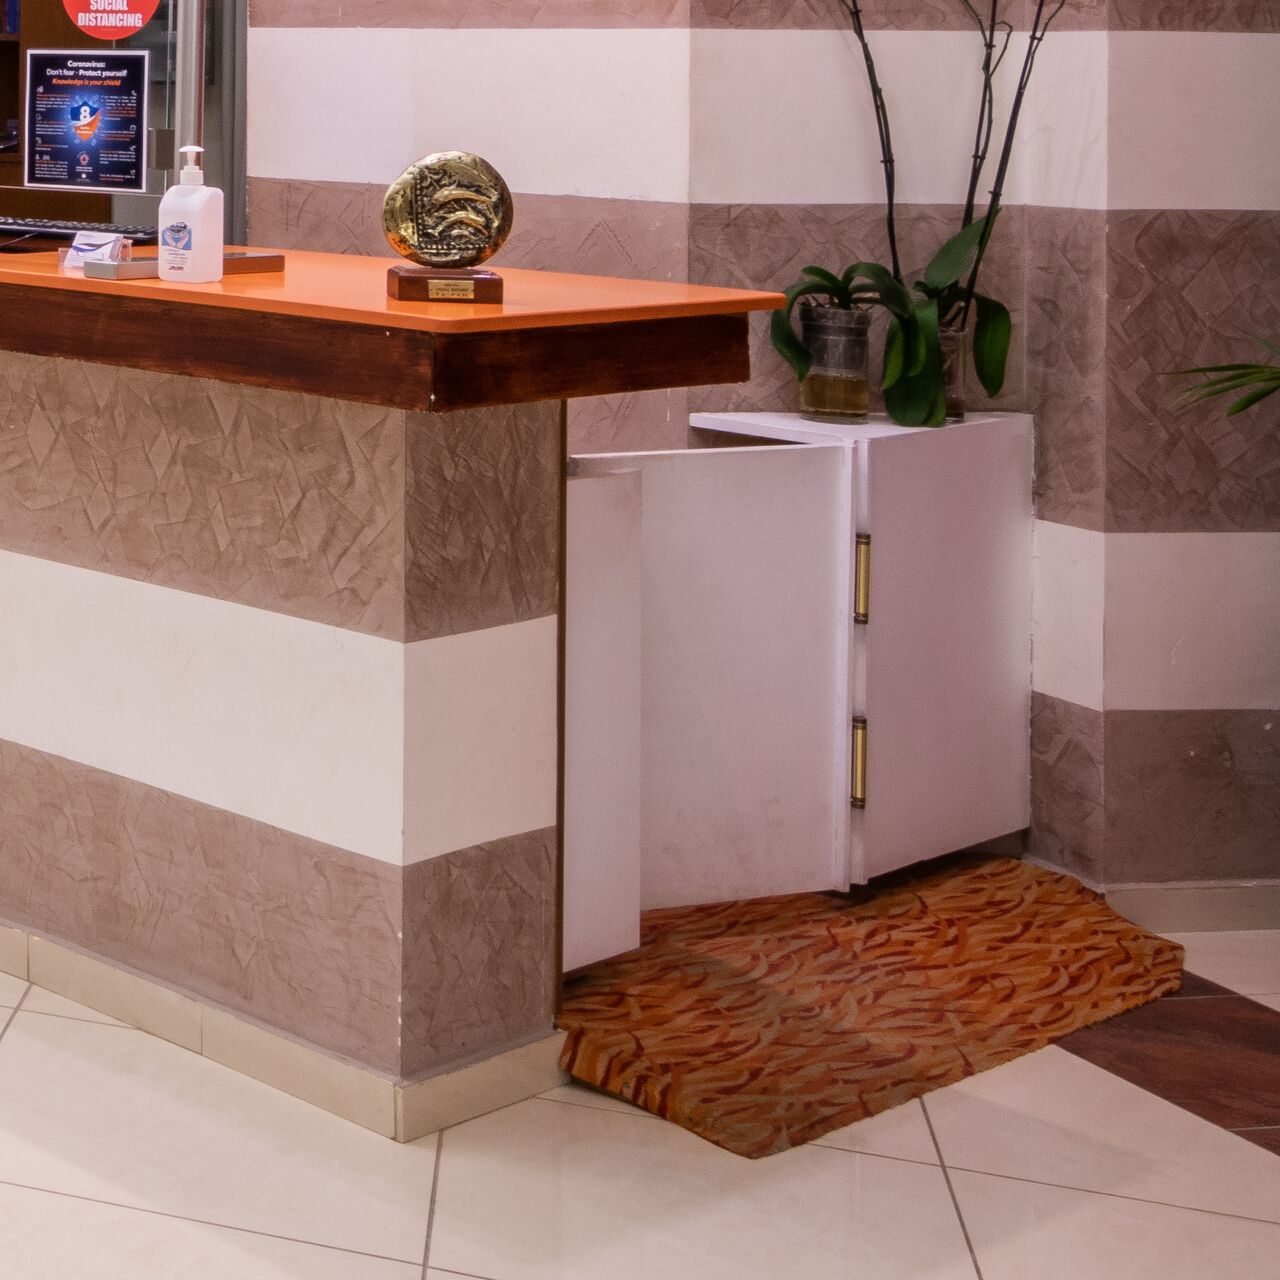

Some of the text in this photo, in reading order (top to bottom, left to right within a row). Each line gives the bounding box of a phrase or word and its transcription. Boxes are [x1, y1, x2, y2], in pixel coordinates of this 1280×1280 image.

[77, 12, 142, 27] DISTANCING
[67, 60, 105, 68] Coronavirus:
[46, 68, 63, 76] Don't
[64, 68, 75, 76] fear
[79, 69, 102, 77] Protect
[102, 69, 128, 78] yourself
[52, 78, 84, 86] Knowledge
[103, 79, 121, 87] shield
